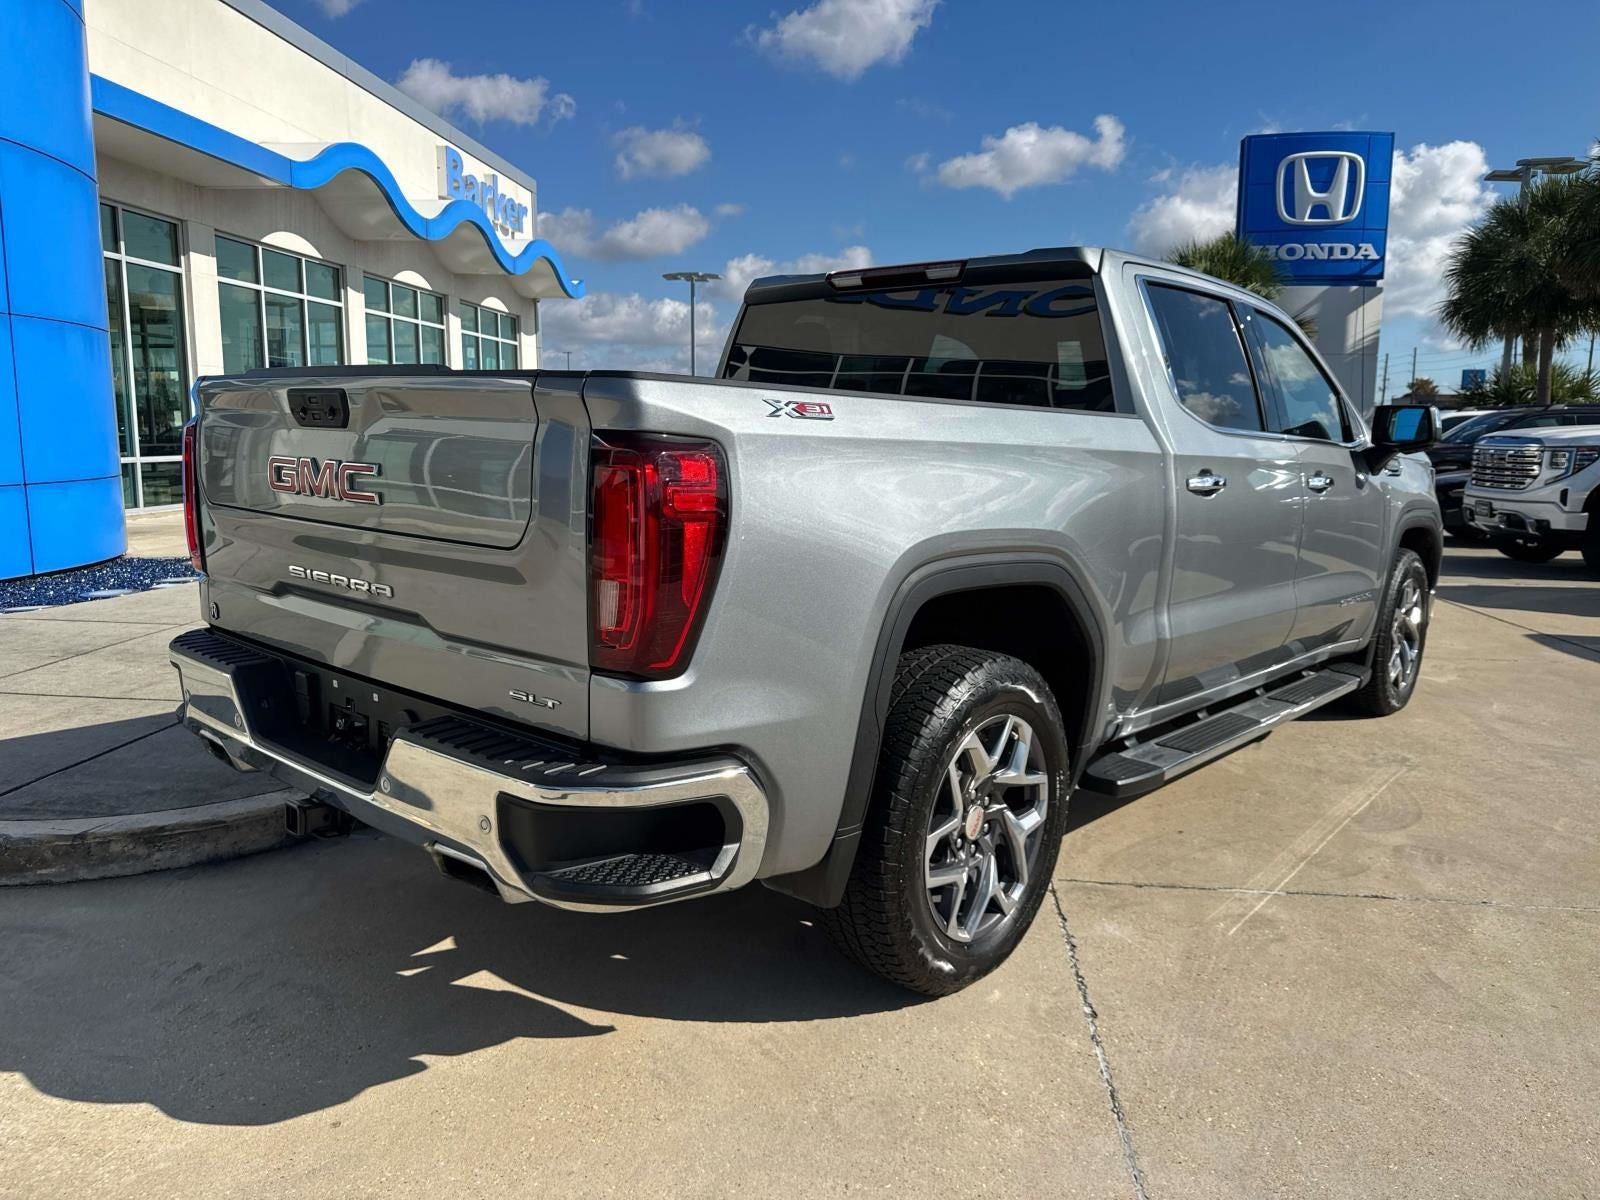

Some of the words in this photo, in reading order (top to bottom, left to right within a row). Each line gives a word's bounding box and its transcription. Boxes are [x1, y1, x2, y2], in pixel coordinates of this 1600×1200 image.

[445, 146, 528, 233] Barker
[1250, 243, 1380, 260] HONDA
[268, 455, 383, 505] GMC
[288, 565, 394, 598] SIERRA
[508, 689, 562, 709] SLT
